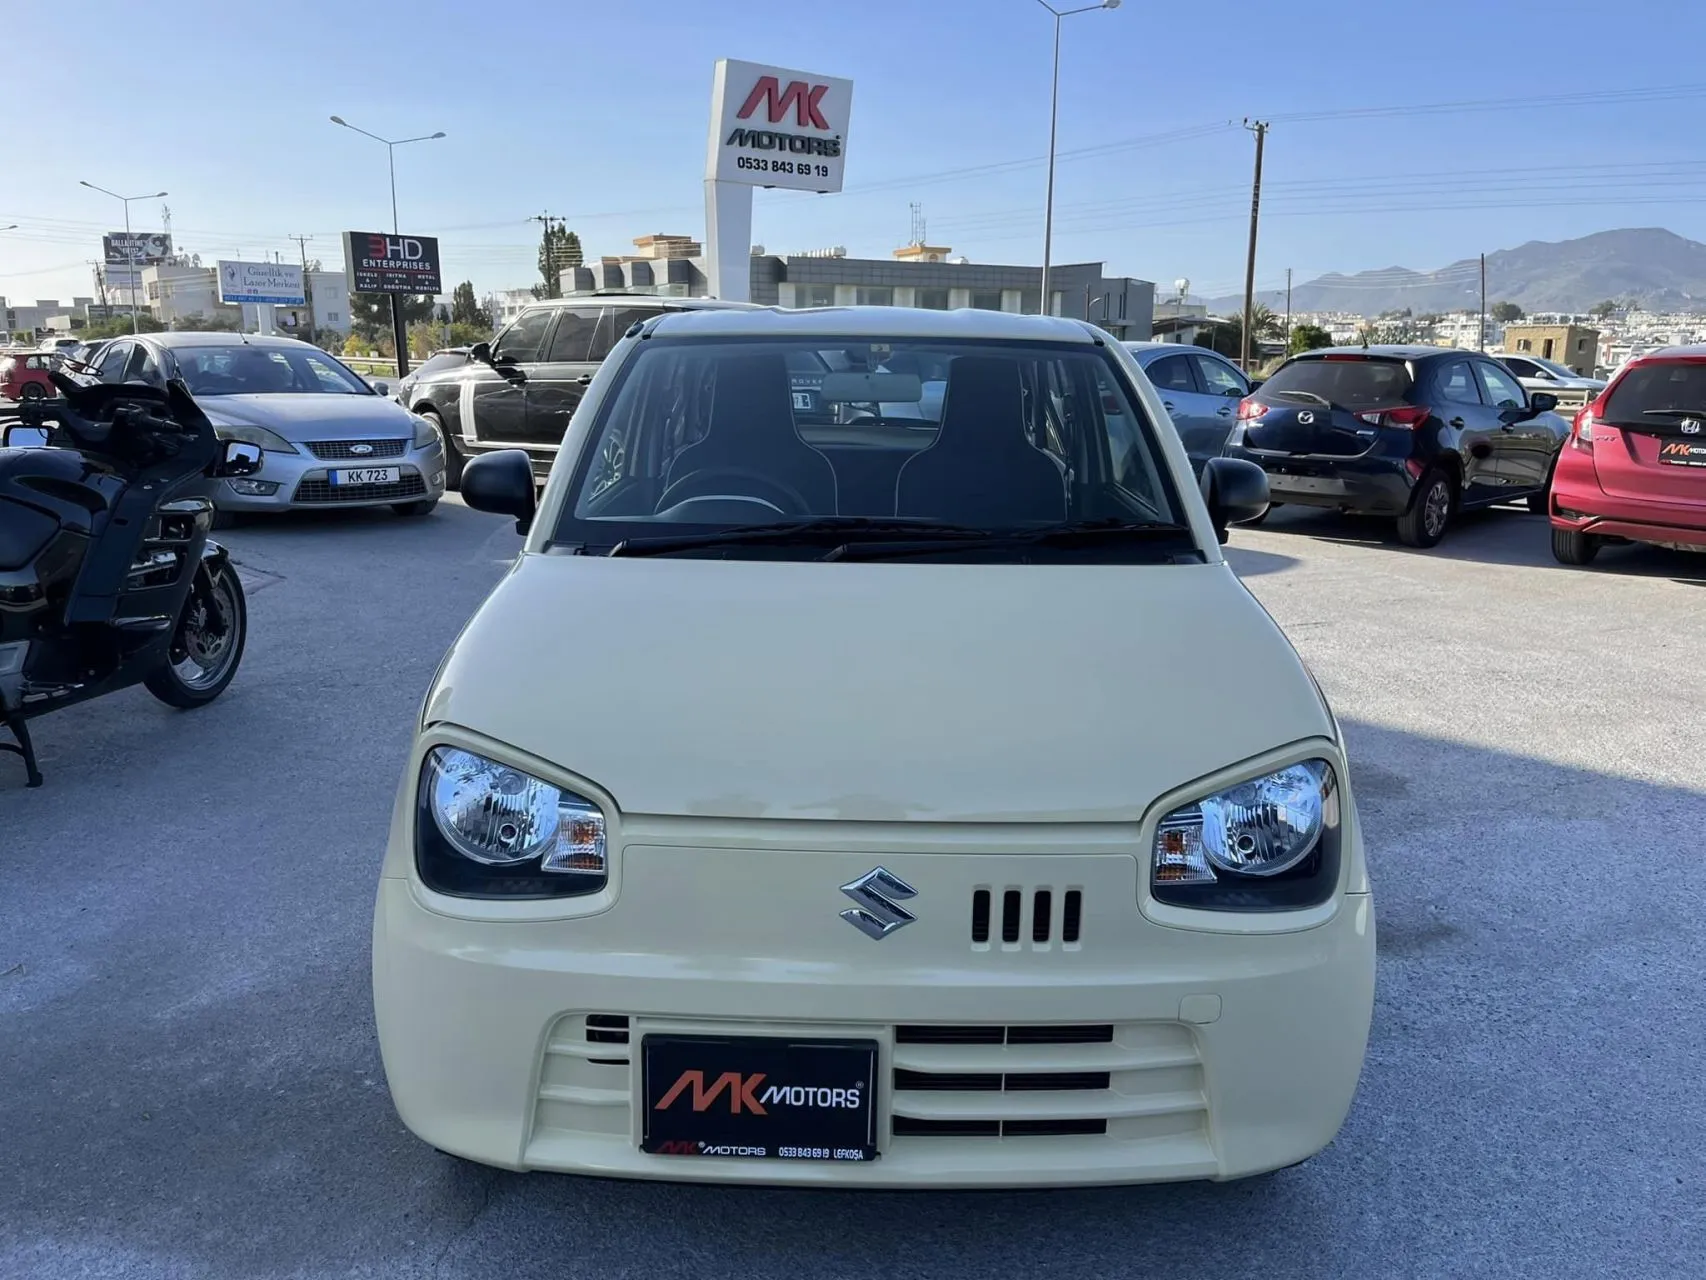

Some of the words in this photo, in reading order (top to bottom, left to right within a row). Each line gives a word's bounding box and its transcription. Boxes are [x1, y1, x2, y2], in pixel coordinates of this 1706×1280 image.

[736, 75, 830, 130] MK
[726, 128, 841, 157] MOTORS
[737, 156, 768, 171] 0533
[772, 160, 794, 174] 843
[797, 163, 811, 175] 69
[815, 165, 828, 177] 19
[368, 234, 423, 260] 3HD
[362, 258, 431, 271] ENTERPRISES
[347, 470, 363, 482] KK
[367, 469, 388, 481] 723
[654, 1069, 768, 1115] MK
[759, 1086, 860, 1109] MOTORS
[702, 1144, 766, 1156] MOTORS
[778, 1146, 797, 1157] 0533
[797, 1147, 811, 1158] 843
[812, 1147, 821, 1158] 69
[822, 1147, 830, 1159] 19
